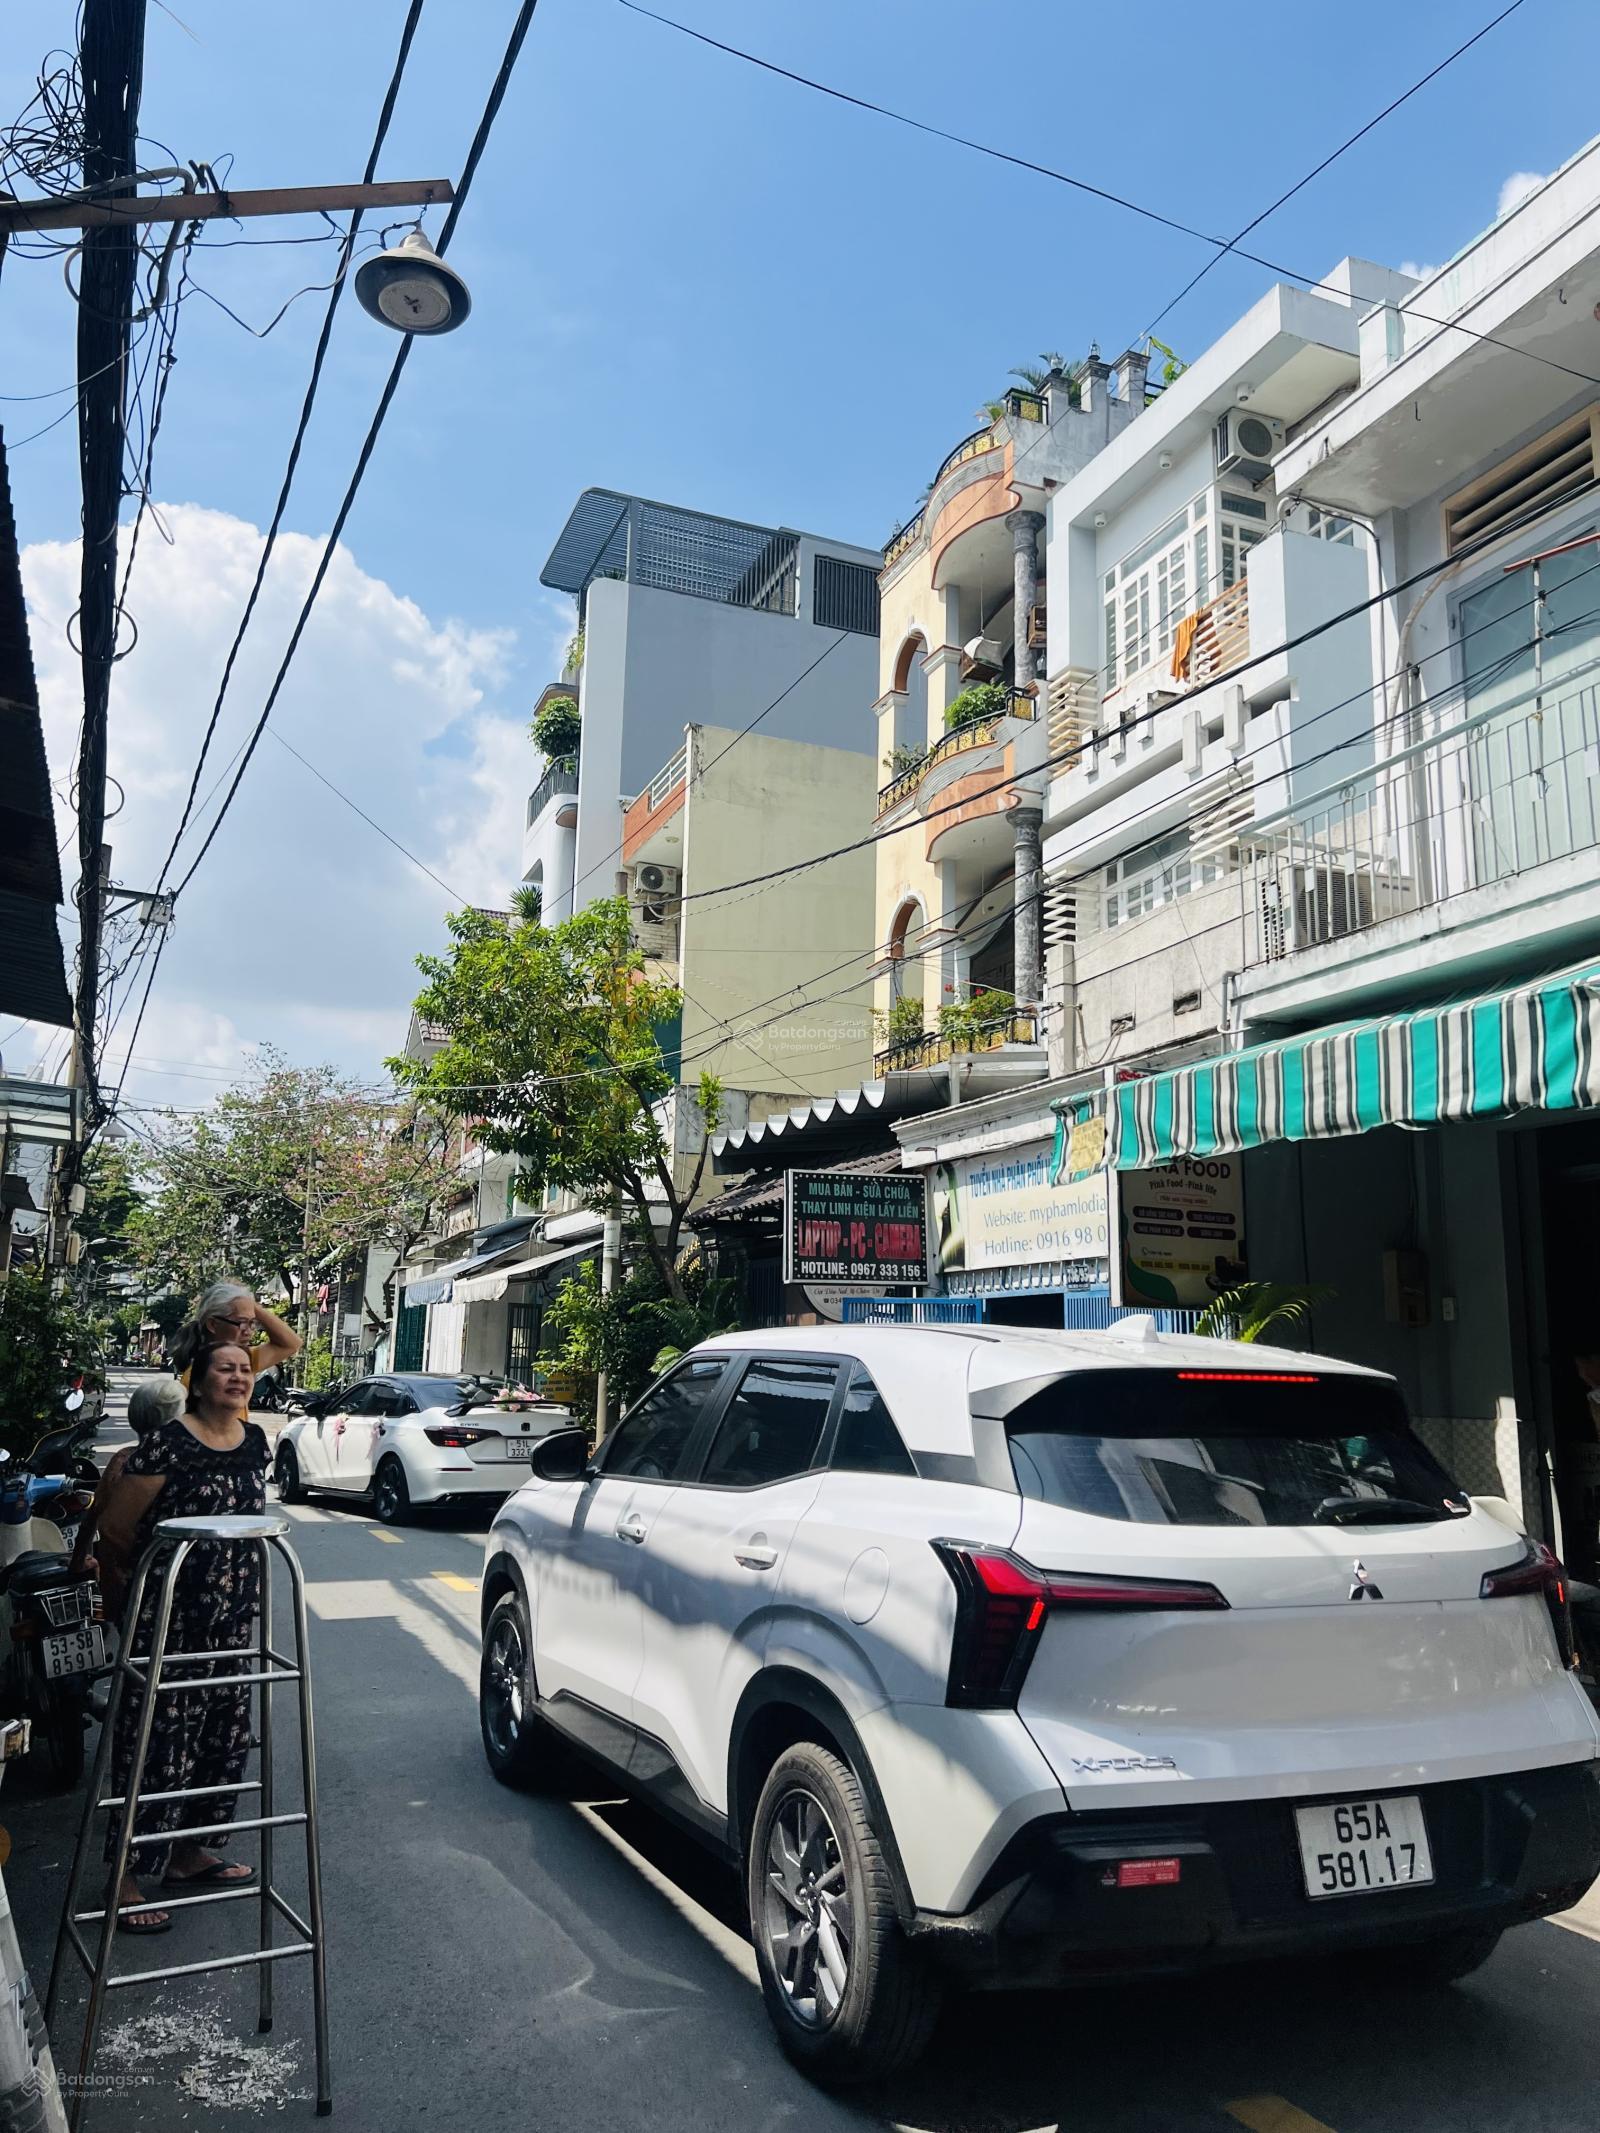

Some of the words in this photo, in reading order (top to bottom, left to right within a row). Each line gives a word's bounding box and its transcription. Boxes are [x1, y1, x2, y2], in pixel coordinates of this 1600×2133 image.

[1006, 1159, 1026, 1191] PHÂN
[1184, 1159, 1231, 1179] FOOD
[808, 1182, 831, 1196] MUA
[834, 1180, 853, 1197] BÁN
[863, 1181, 881, 1199] SỬA
[884, 1184, 911, 1200] CHỮA
[801, 1200, 826, 1214] THAY
[829, 1201, 851, 1216] LINH
[854, 1200, 876, 1219] KIỆN
[879, 1200, 896, 1217] LẤY
[984, 1210, 1027, 1227] Website:
[798, 1220, 841, 1258] LAPTOP
[850, 1221, 866, 1259] PC
[875, 1222, 921, 1260] CAMERA
[984, 1236, 1032, 1256] Hotline:
[1036, 1230, 1070, 1249] 0916
[1075, 1227, 1093, 1244] 98
[801, 1261, 848, 1275] HOTLINE:
[850, 1262, 877, 1276] 0967
[880, 1264, 899, 1277] 333
[901, 1264, 920, 1277] 156
[50, 1630, 94, 1656] 53-SB
[52, 1651, 95, 1675] 8591
[1334, 1803, 1391, 1843] 65A
[1317, 1843, 1416, 1890] 581.17
